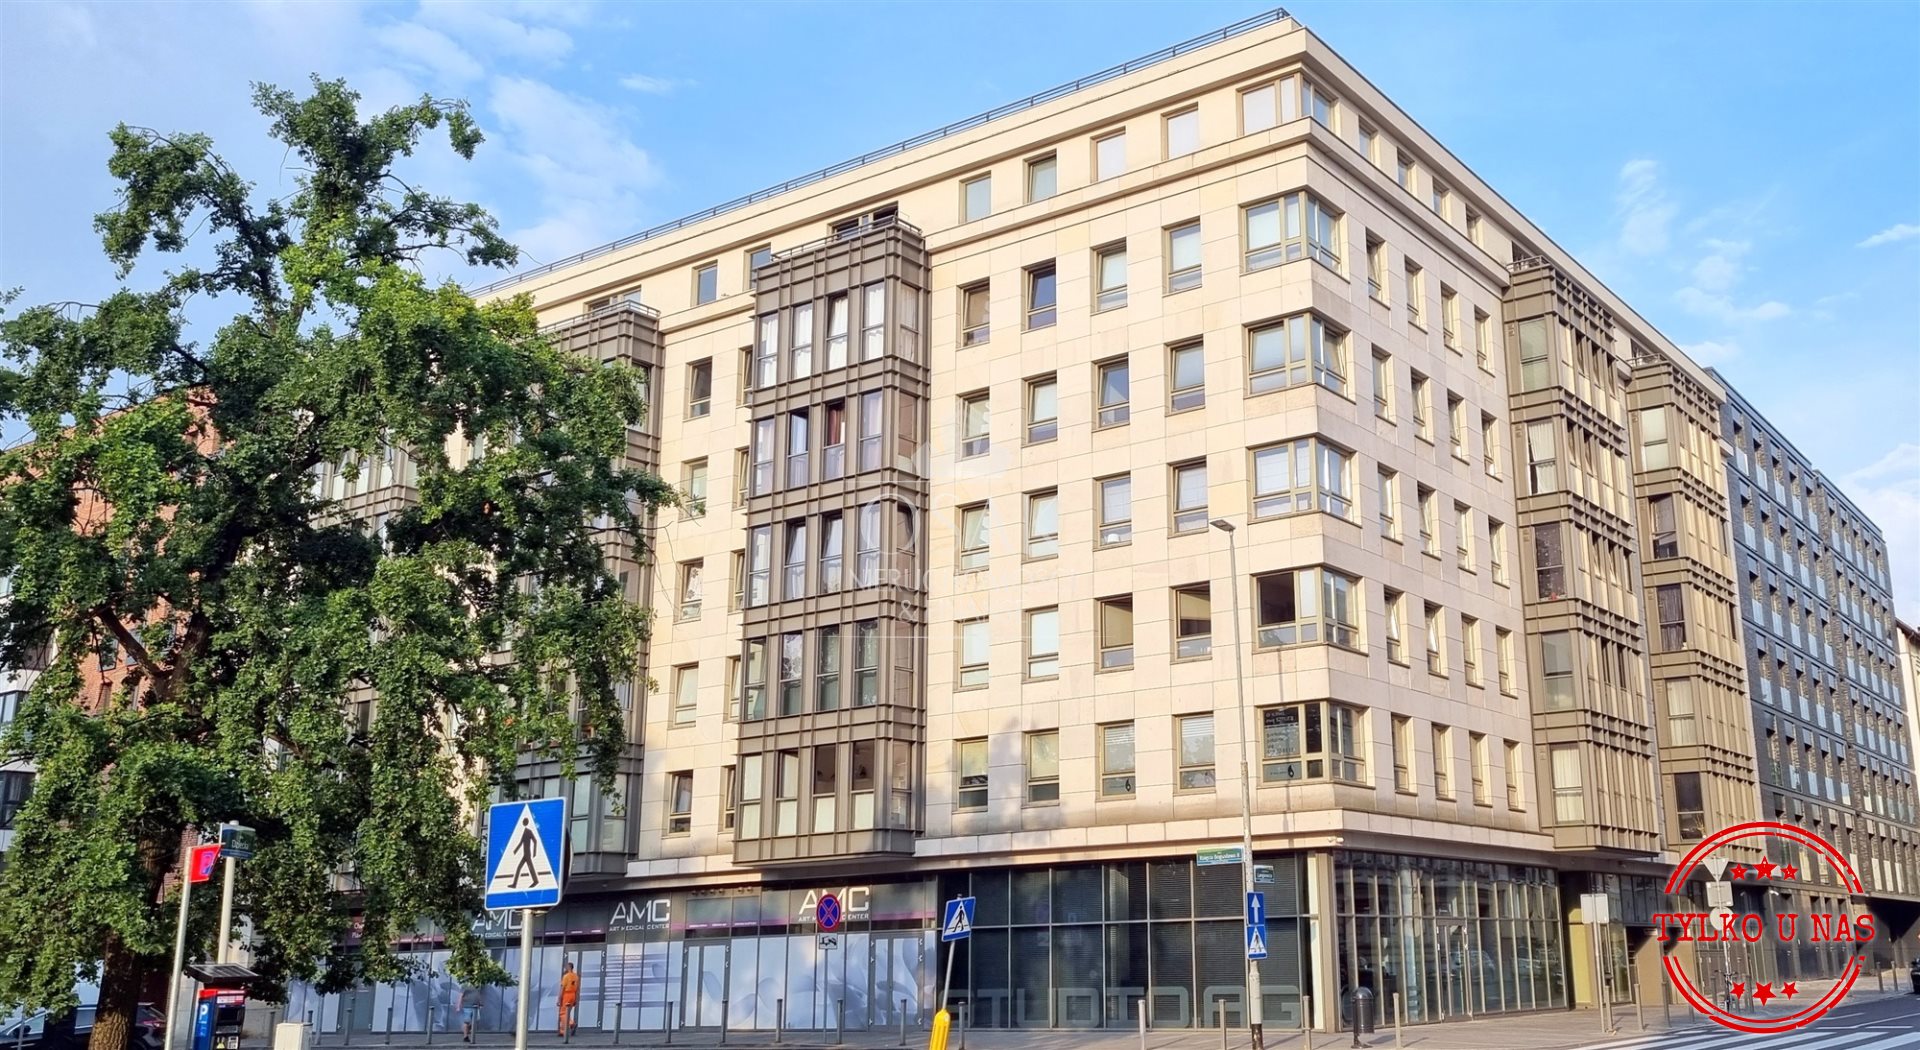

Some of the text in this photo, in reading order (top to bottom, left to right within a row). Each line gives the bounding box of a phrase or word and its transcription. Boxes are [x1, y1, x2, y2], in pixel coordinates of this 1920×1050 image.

[471, 909, 522, 931] AMC
[609, 898, 671, 925] AMC
[198, 1003, 209, 1020] P
